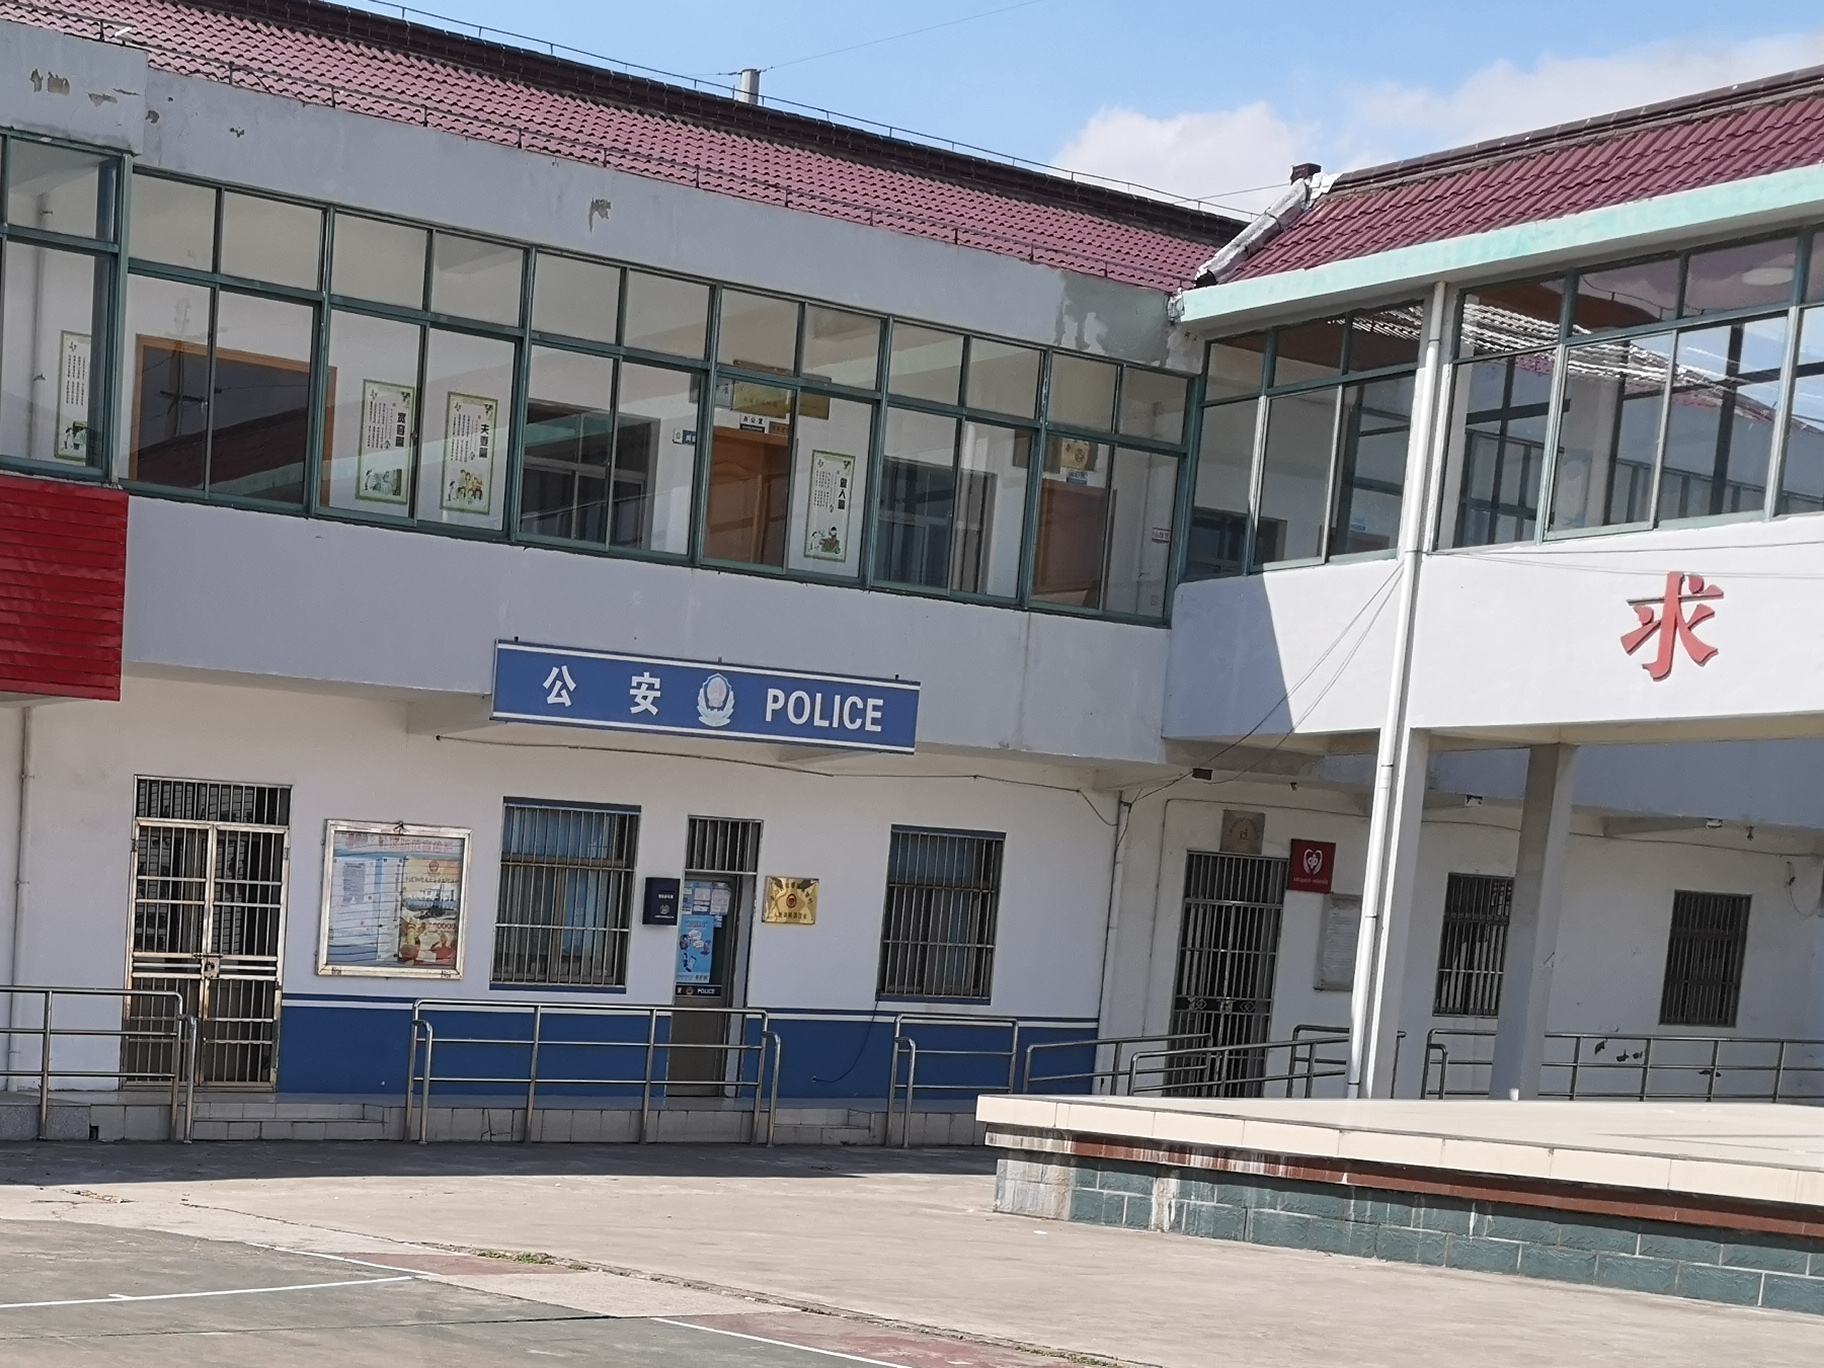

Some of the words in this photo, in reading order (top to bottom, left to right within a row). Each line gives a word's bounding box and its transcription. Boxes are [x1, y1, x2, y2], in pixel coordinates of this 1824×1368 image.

[1620, 571, 1724, 682] 求
[542, 664, 662, 716] 公安
[764, 688, 884, 733] POLICE
